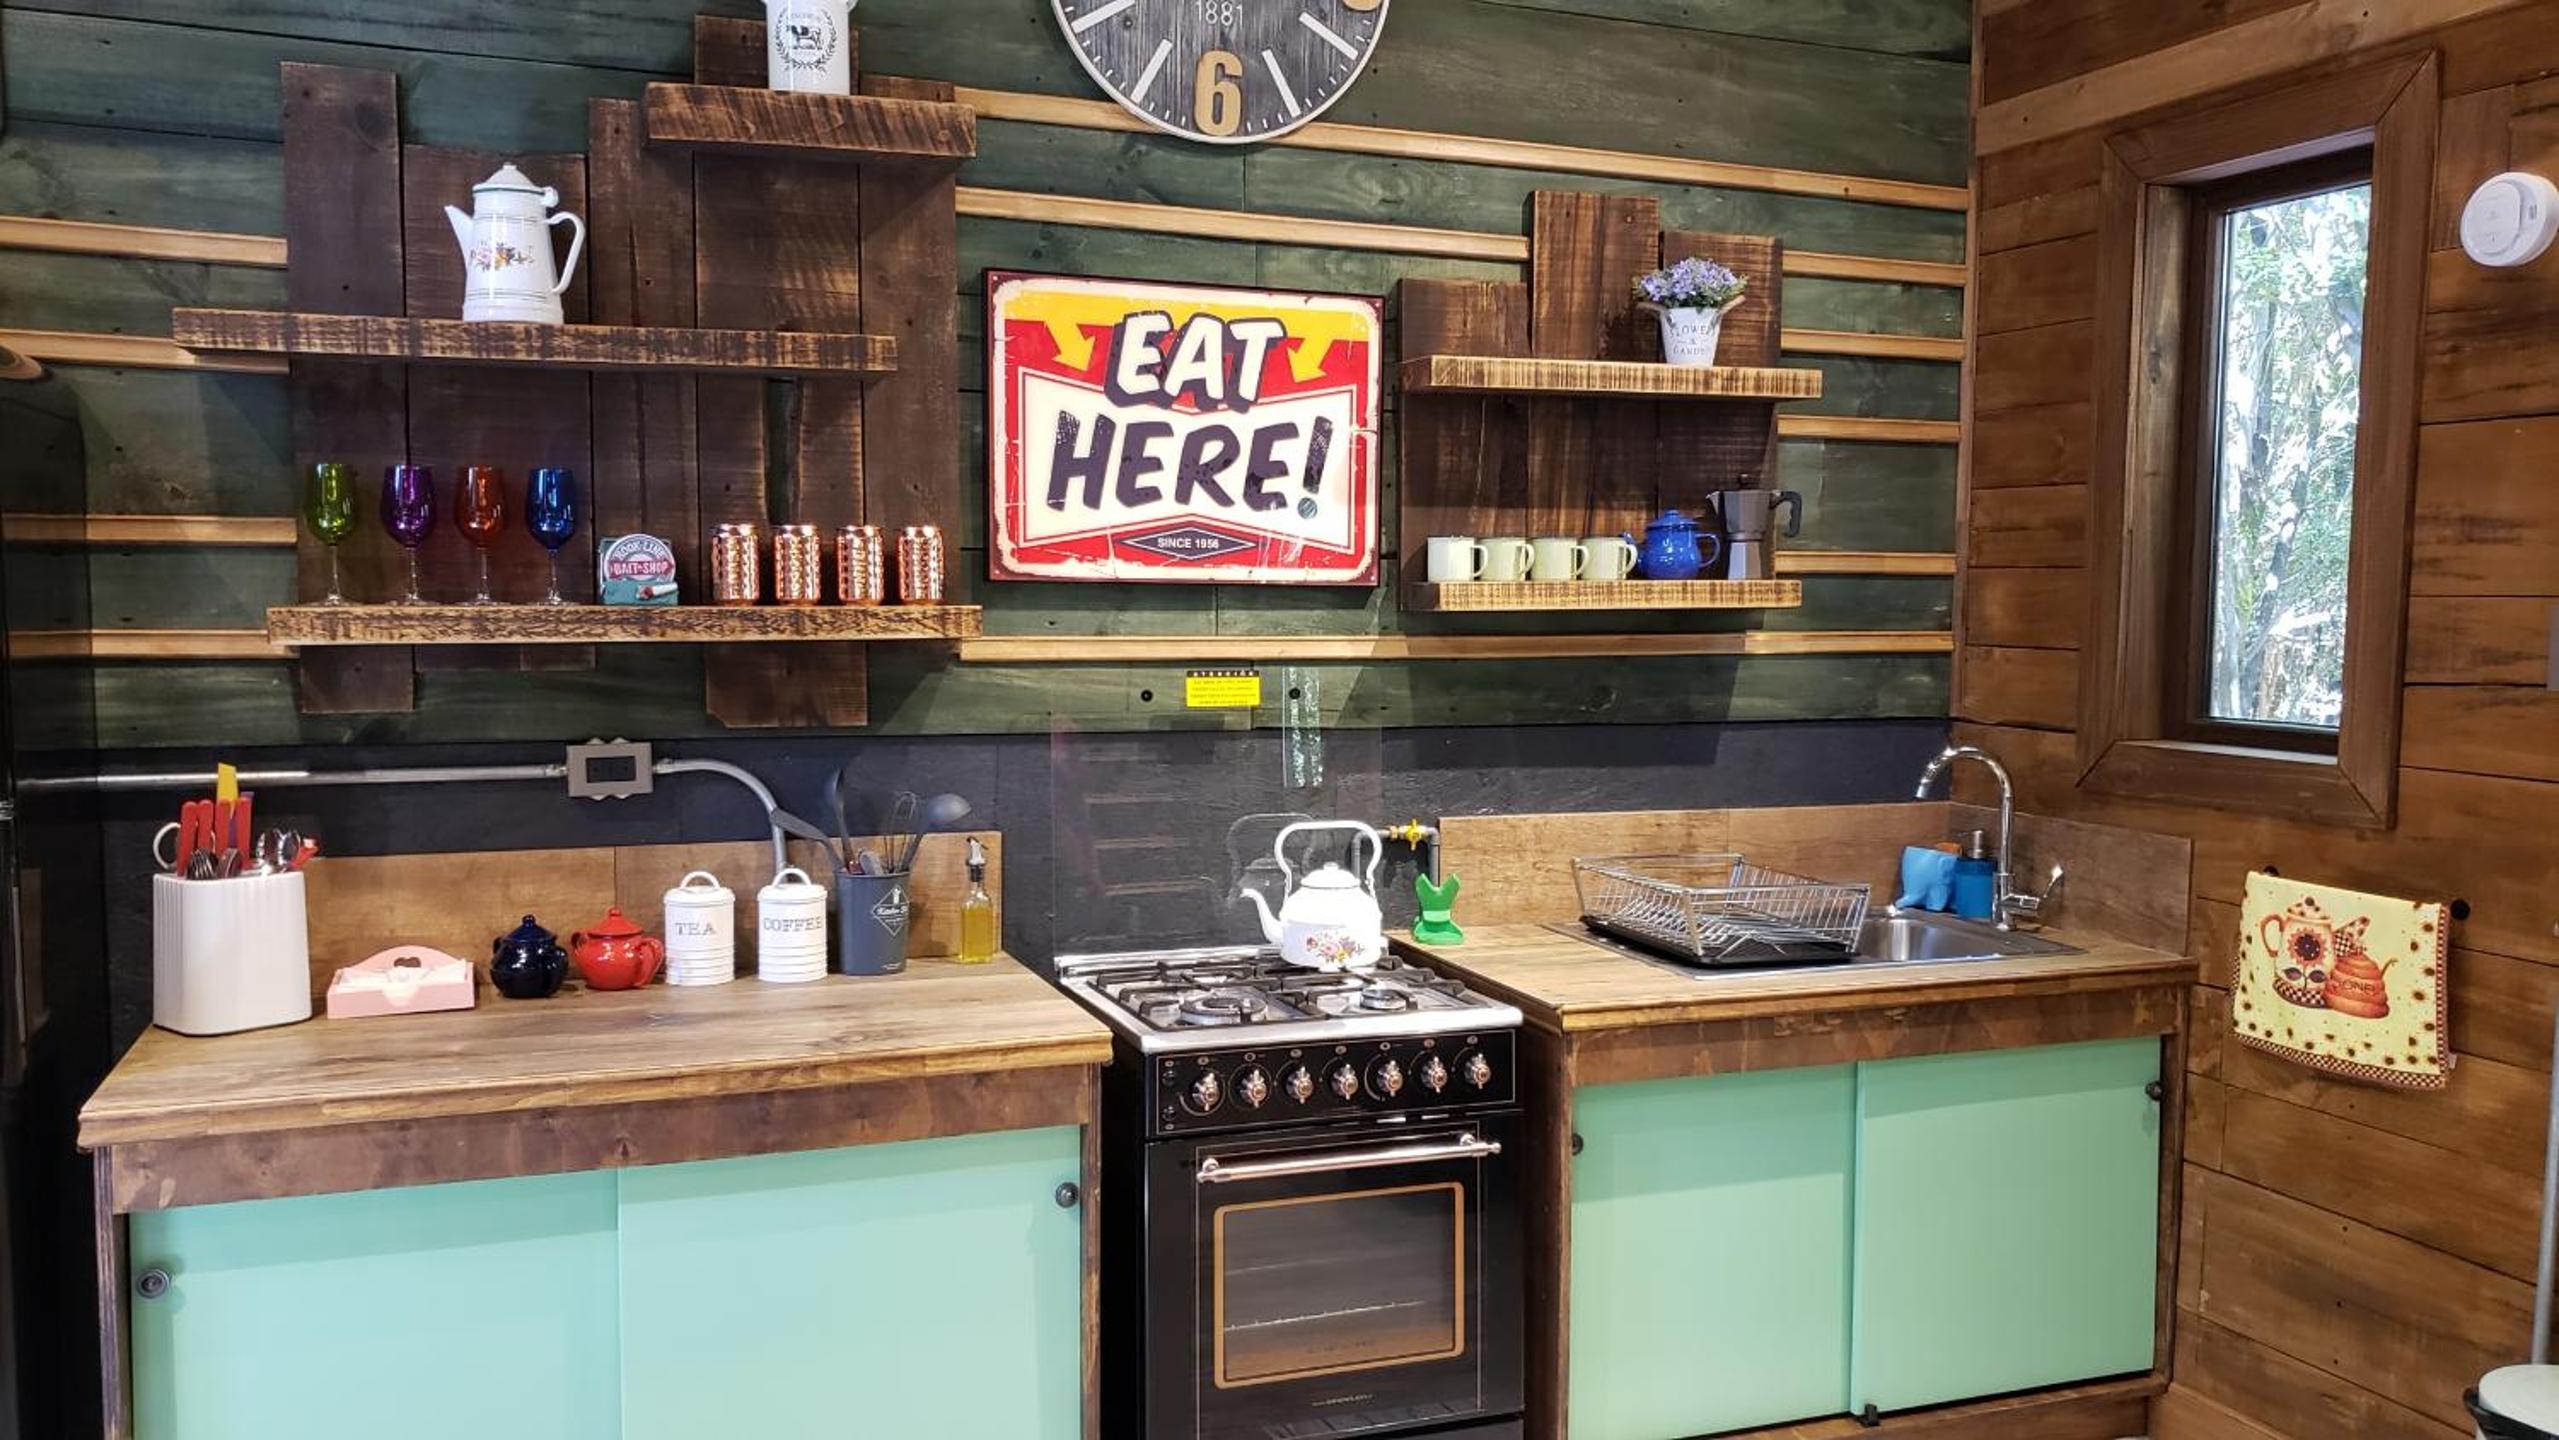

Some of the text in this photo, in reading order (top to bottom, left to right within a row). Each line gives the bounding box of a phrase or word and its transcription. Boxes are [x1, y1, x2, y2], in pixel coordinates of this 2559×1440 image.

[1196, 0, 1243, 30] 1881
[1195, 50, 1243, 136] 6
[1104, 310, 1288, 414] EAT
[1047, 410, 1333, 519] HERE!
[1157, 538, 1192, 549] SINCE
[675, 922, 717, 936] TEA
[763, 915, 823, 932] COFFEE
